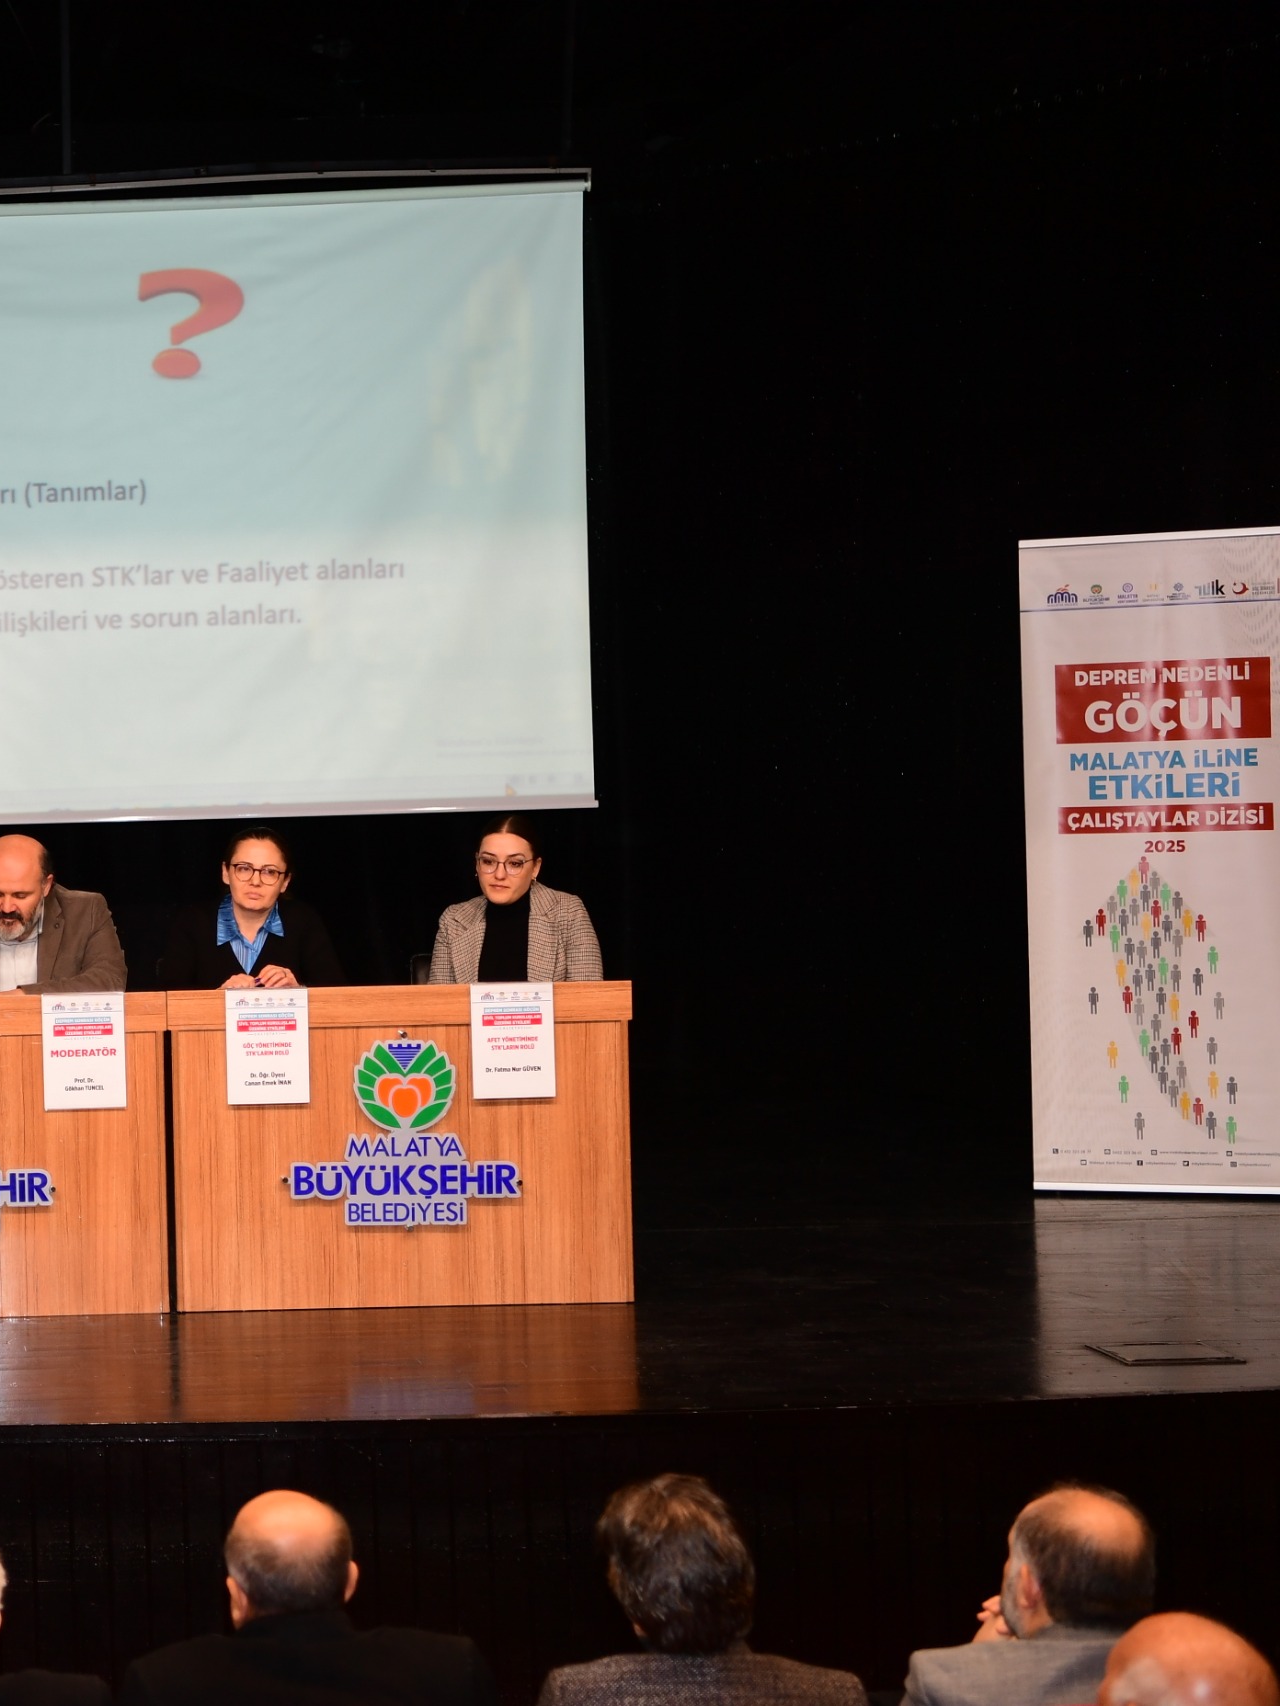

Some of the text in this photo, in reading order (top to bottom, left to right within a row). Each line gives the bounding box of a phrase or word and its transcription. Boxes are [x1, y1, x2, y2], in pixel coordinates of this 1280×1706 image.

[23, 480, 148, 509] (Tanımlar)
[181, 567, 209, 584] ve
[217, 560, 309, 587] Faaliyet
[316, 558, 406, 580] alanları
[95, 614, 122, 631] ve
[130, 610, 198, 629] sorun
[206, 604, 302, 626] alanları.
[1074, 660, 1250, 687] DEPREM NEDENLİ
[1084, 689, 1242, 738] GÖÇÜN
[1070, 747, 1259, 771] MALATYA İLİNE
[1088, 771, 1240, 801] ETKİLERİ
[1067, 805, 1265, 831] ÇALIŞTAYLAR DİZİSİ
[1144, 839, 1186, 853] 2025
[50, 1046, 117, 1058] MODERATÖR
[348, 1136, 463, 1158] MALATYA
[293, 1164, 517, 1199] BÜYÜKŞEHİR
[348, 1202, 464, 1222] BELEDİYESİ
